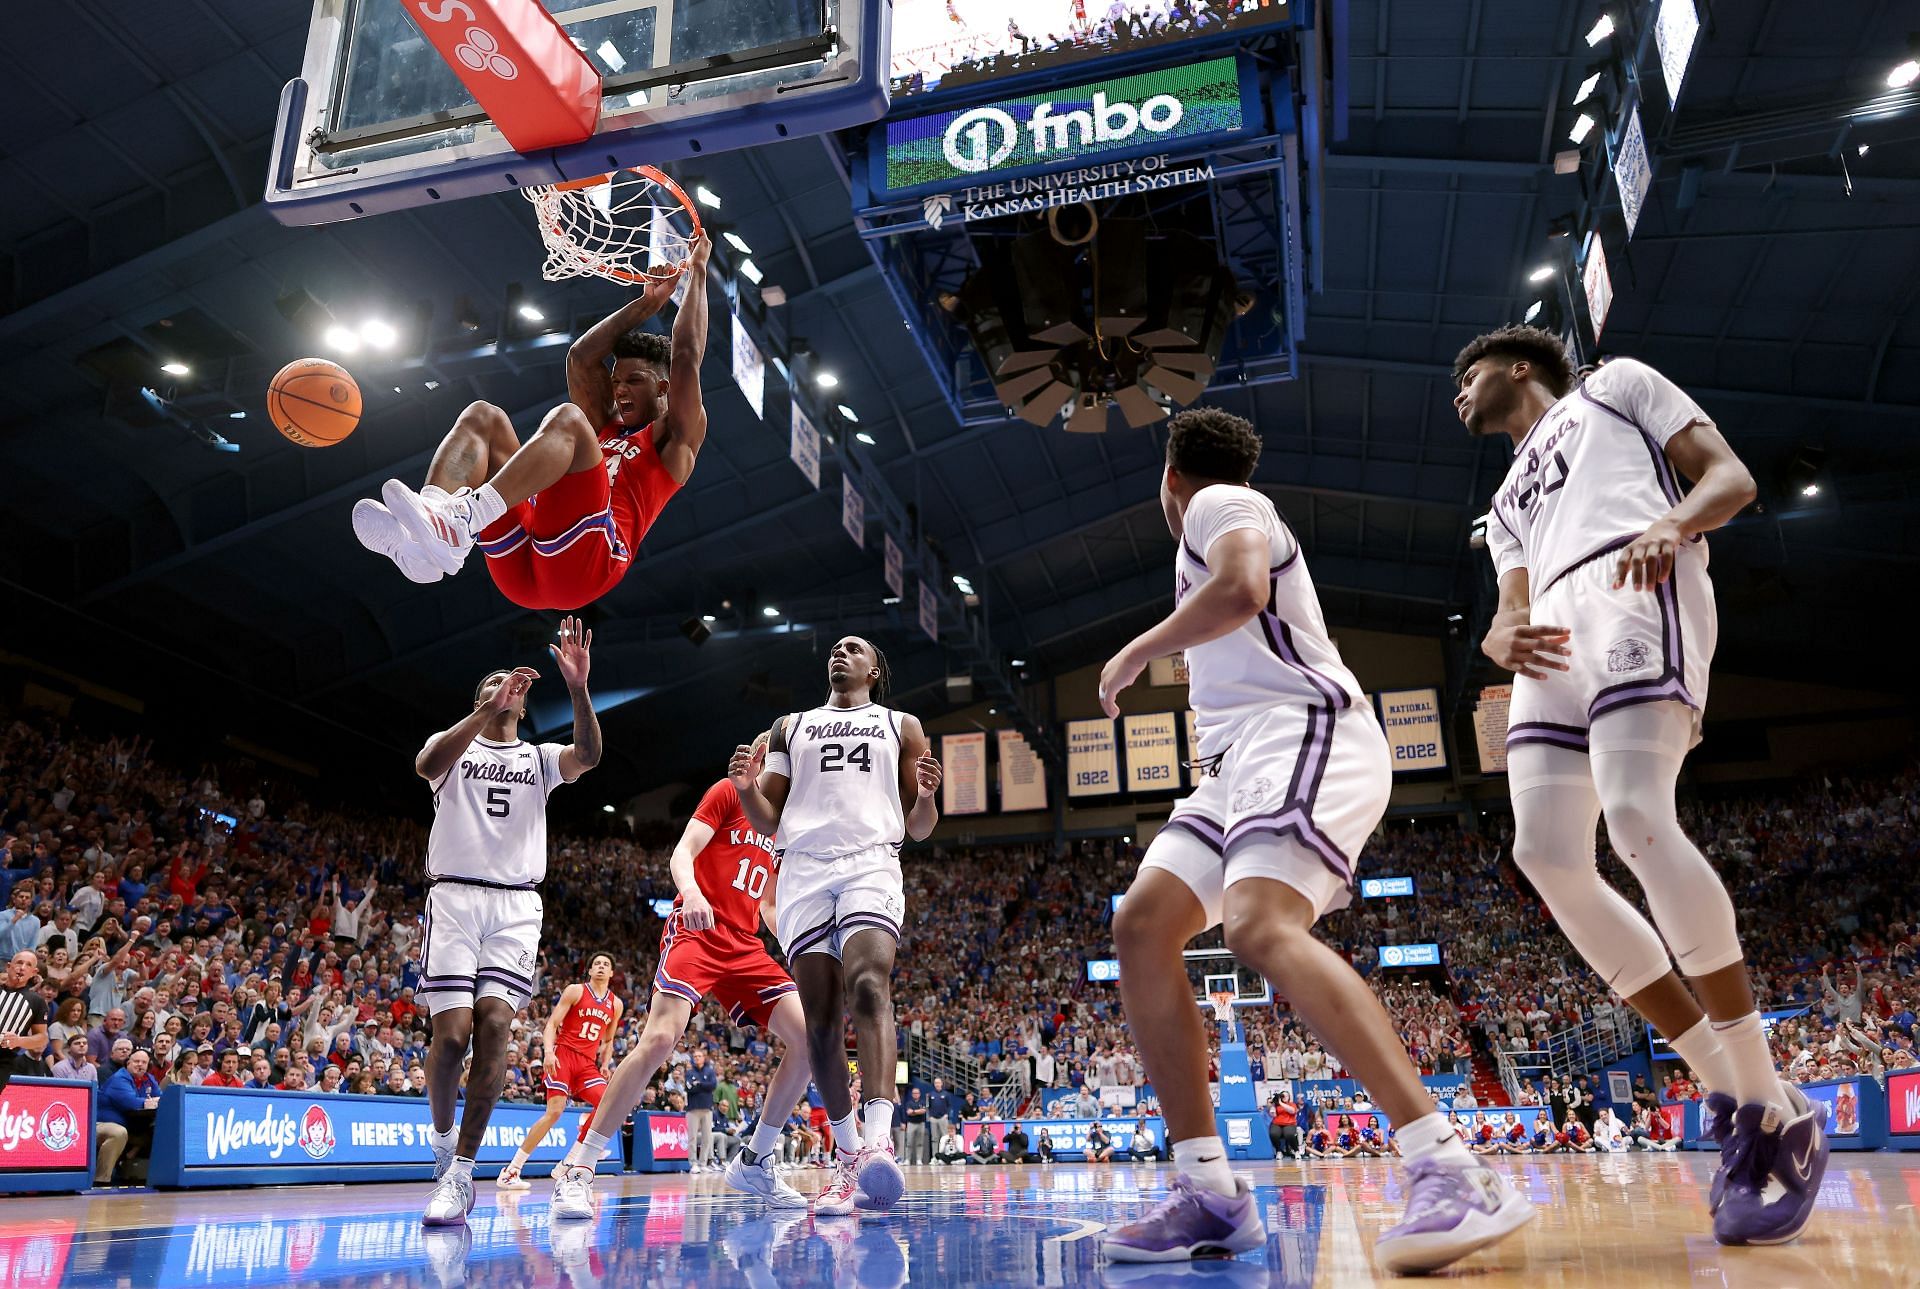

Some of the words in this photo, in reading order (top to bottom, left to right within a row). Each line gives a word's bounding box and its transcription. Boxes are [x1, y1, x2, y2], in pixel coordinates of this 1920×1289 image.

[1026, 91, 1184, 153] fnbo
[962, 183, 1005, 204] THE
[1010, 158, 1138, 195] UNIVERSITY
[1141, 153, 1169, 171] OF
[963, 194, 1044, 222] KANSAS
[1047, 178, 1131, 208] HEALTH
[1135, 165, 1216, 192] SYSTEM
[600, 438, 641, 460] SAS
[1389, 702, 1433, 714] NATIONAL
[1386, 713, 1439, 727] CHAMPIONS
[805, 721, 887, 741] Wildcats
[1072, 731, 1109, 741] NATIONAL
[1131, 726, 1170, 736] NATIONAL
[1068, 743, 1113, 753] CHAMPIONS
[1127, 737, 1175, 749] CHAMPIONS
[1395, 743, 1437, 760] 2022
[820, 742, 871, 773] 24
[461, 760, 537, 785] Wildcats
[1076, 770, 1109, 786] 1922
[1137, 765, 1170, 780] 1923
[486, 787, 512, 818] 5
[731, 858, 769, 900] 10
[1403, 946, 1433, 957] Capitol
[1404, 955, 1434, 963] Federal
[578, 1021, 601, 1041] 15
[206, 1104, 297, 1160] Wendy's
[351, 1122, 415, 1146] HERE'S
[499, 1126, 525, 1147] BIG
